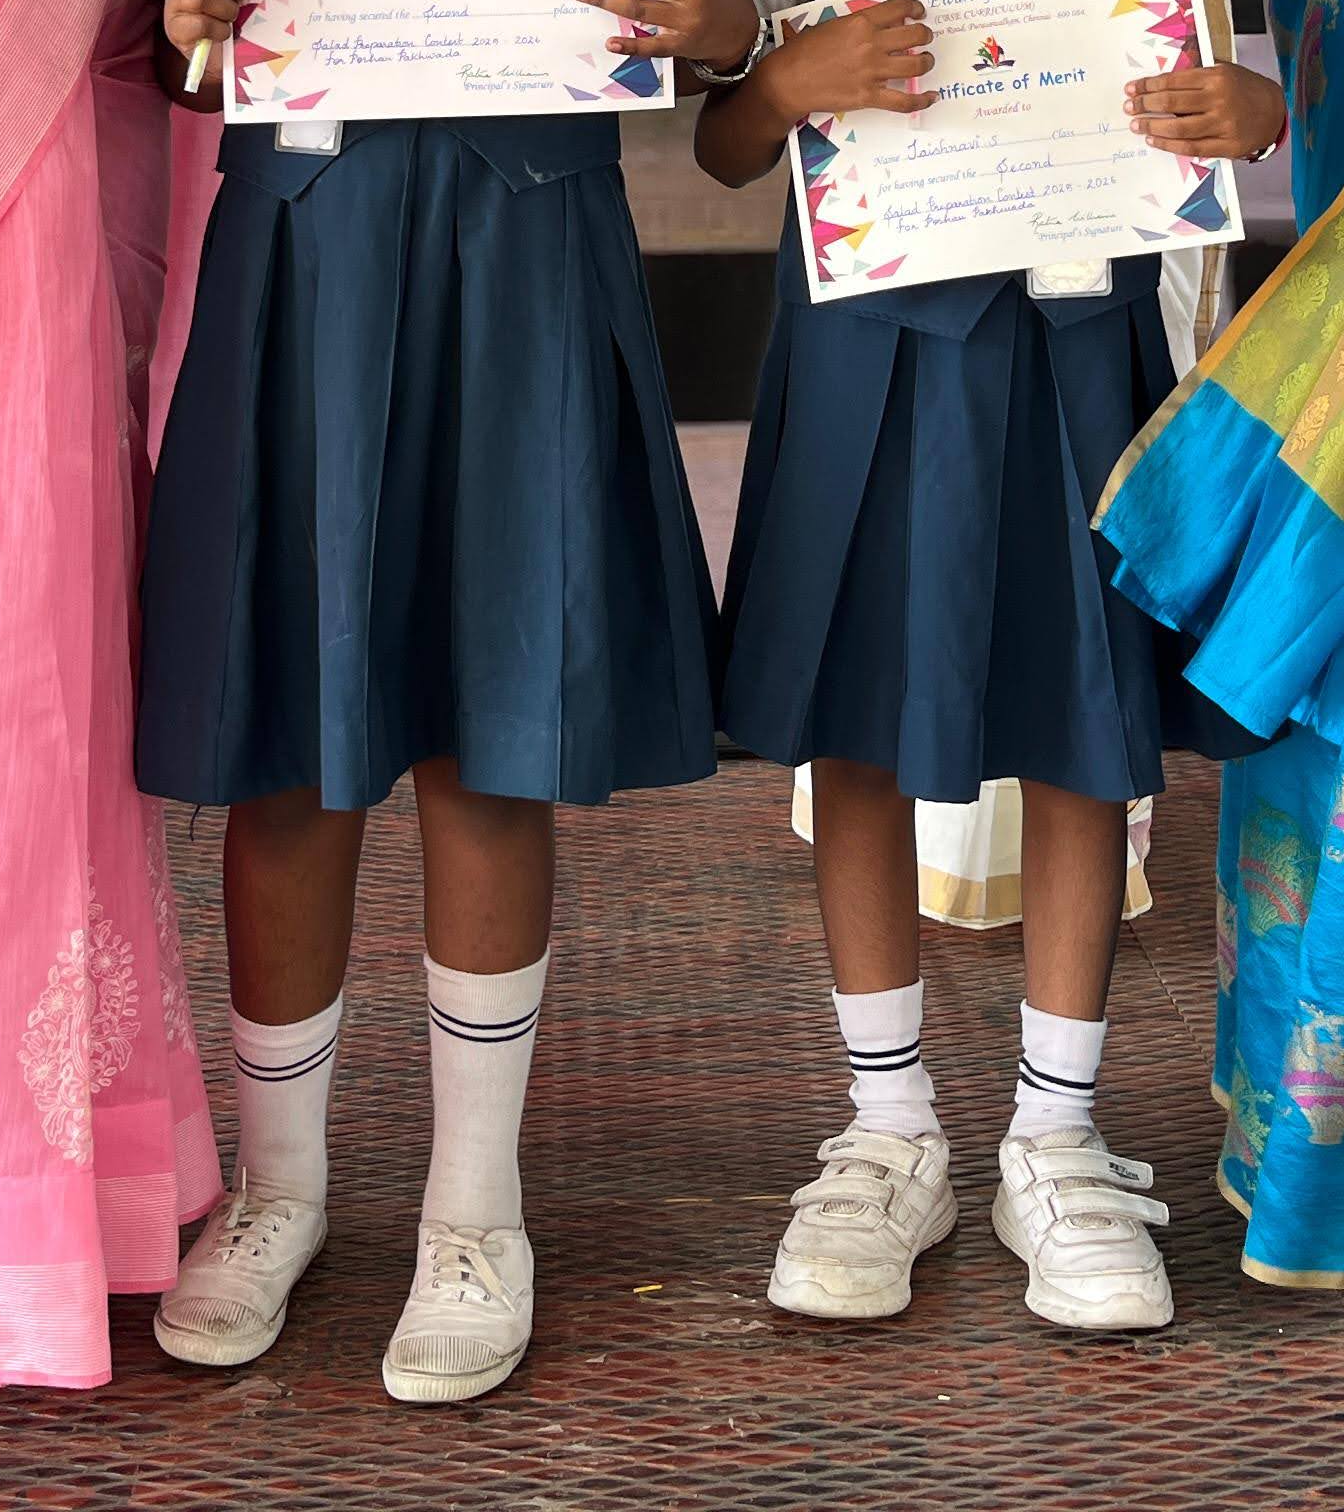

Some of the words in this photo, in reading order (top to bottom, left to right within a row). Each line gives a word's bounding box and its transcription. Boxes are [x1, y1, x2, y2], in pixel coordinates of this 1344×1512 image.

[307, 10, 323, 26] for
[325, 10, 356, 24] having
[358, 9, 393, 21] secured
[395, 9, 410, 20] the
[423, 3, 471, 23] Second
[553, 4, 577, 19] place
[580, 6, 590, 15] in
[512, 81, 554, 93] Signature
[938, 79, 1005, 101] tificate
[1012, 72, 1030, 90] of
[1039, 67, 1086, 87] Merit
[974, 101, 1020, 120] Awarded
[1022, 103, 1033, 113] to
[1051, 127, 1076, 140] Class
[1112, 148, 1136, 164] place
[1138, 148, 1148, 158] in
[996, 152, 1054, 184] Second
[877, 183, 892, 199] for
[894, 176, 925, 190] having
[927, 169, 961, 185] secured
[962, 167, 977, 180] the
[1084, 224, 1124, 240] Signature
